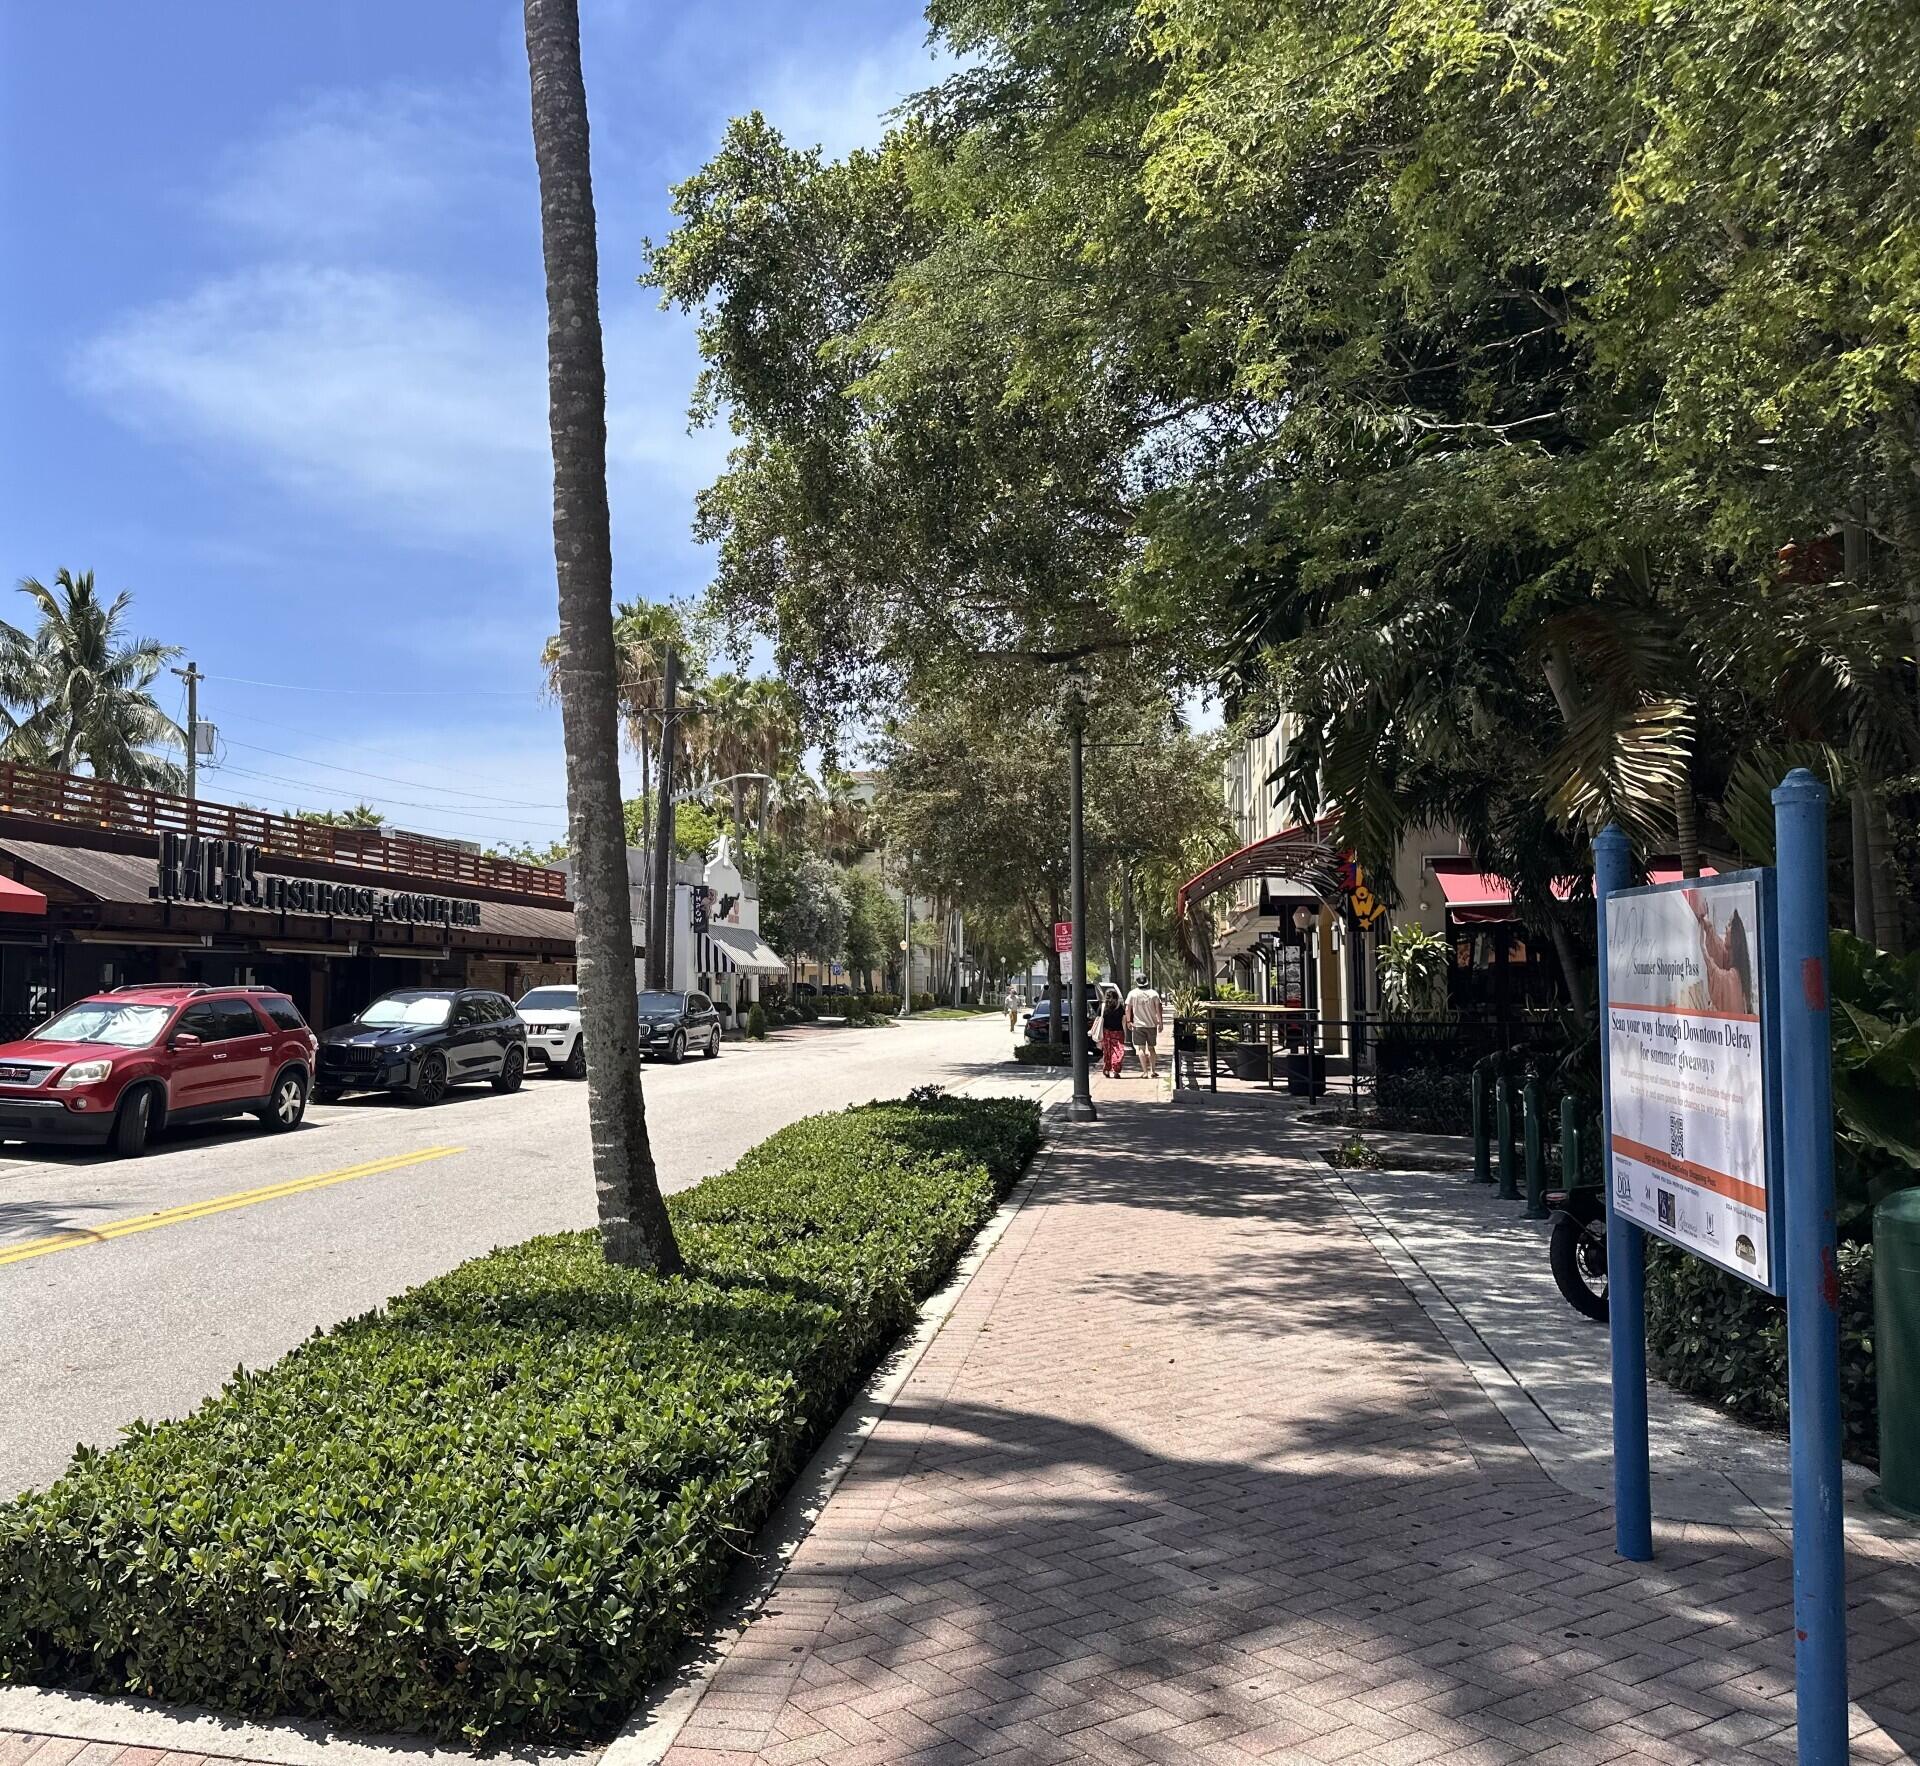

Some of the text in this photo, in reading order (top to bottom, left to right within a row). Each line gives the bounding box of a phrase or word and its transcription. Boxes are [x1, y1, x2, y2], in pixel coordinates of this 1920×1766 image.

[694, 888, 703, 923] THROW
[1633, 957, 1699, 981] Summer Shopping Pass
[1611, 1010, 1752, 1058] Scan your way through Downtown Delray
[1639, 1040, 1715, 1081] for summer giveaways
[1617, 1174, 1631, 1198] DDA
